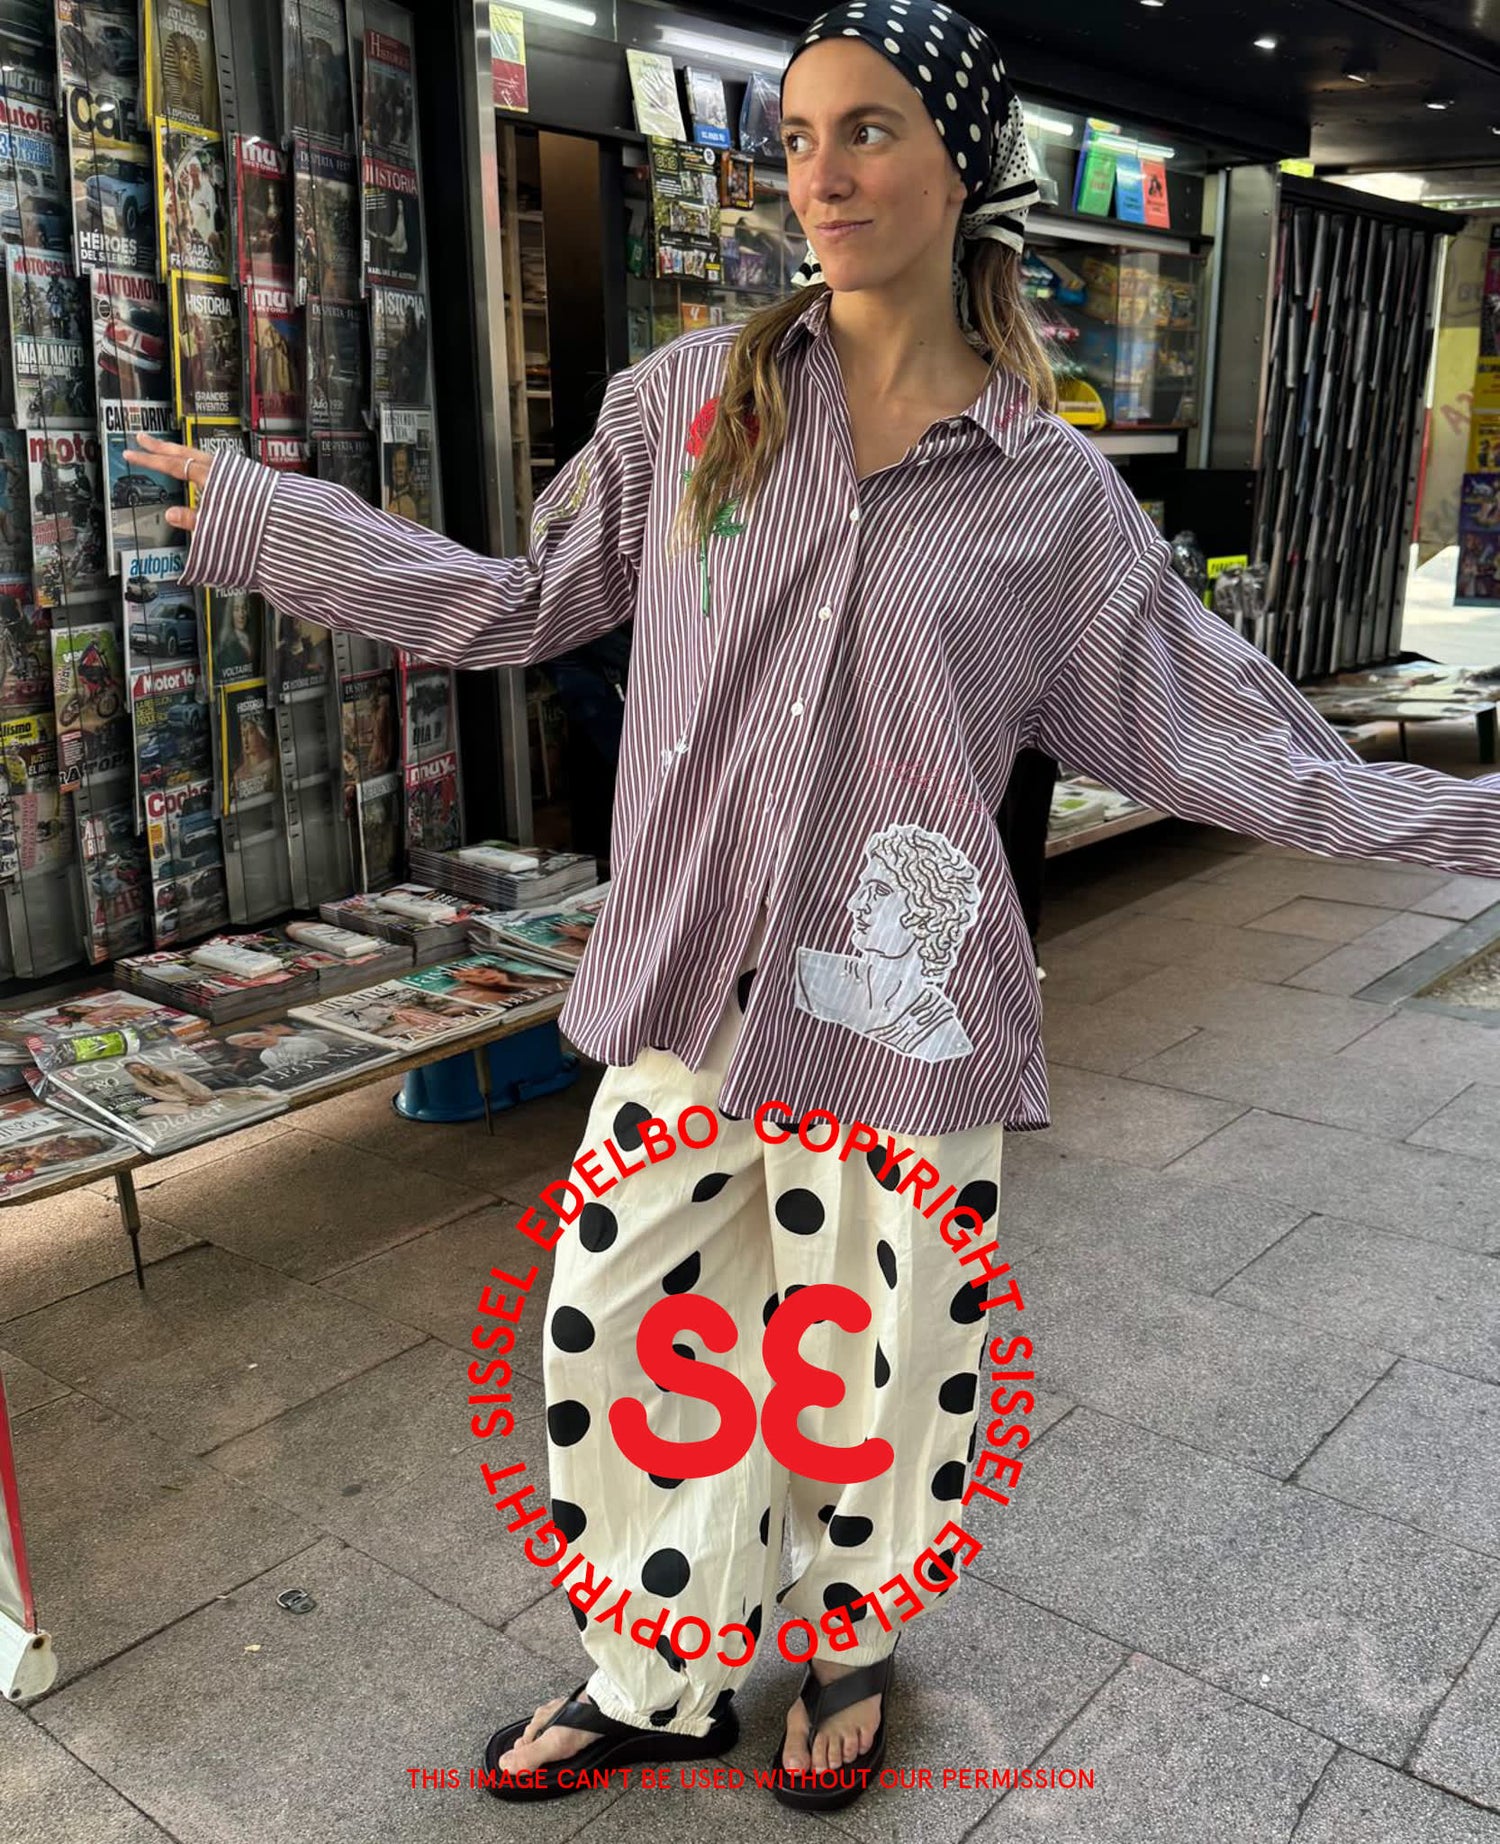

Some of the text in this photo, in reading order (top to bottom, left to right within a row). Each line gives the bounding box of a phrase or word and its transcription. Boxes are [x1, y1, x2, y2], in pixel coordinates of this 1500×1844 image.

[80, 229, 137, 255] HÉROES
[185, 242, 210, 257] PAPA
[81, 248, 97, 260] DEL
[170, 252, 221, 270] FRANCISCO
[185, 293, 231, 316] HISTORIA
[374, 289, 427, 320] HISTORIA
[17, 342, 48, 364] MAXI
[195, 391, 229, 401] GRANDES
[106, 406, 130, 431] CAR
[142, 670, 196, 695] Motor 16
